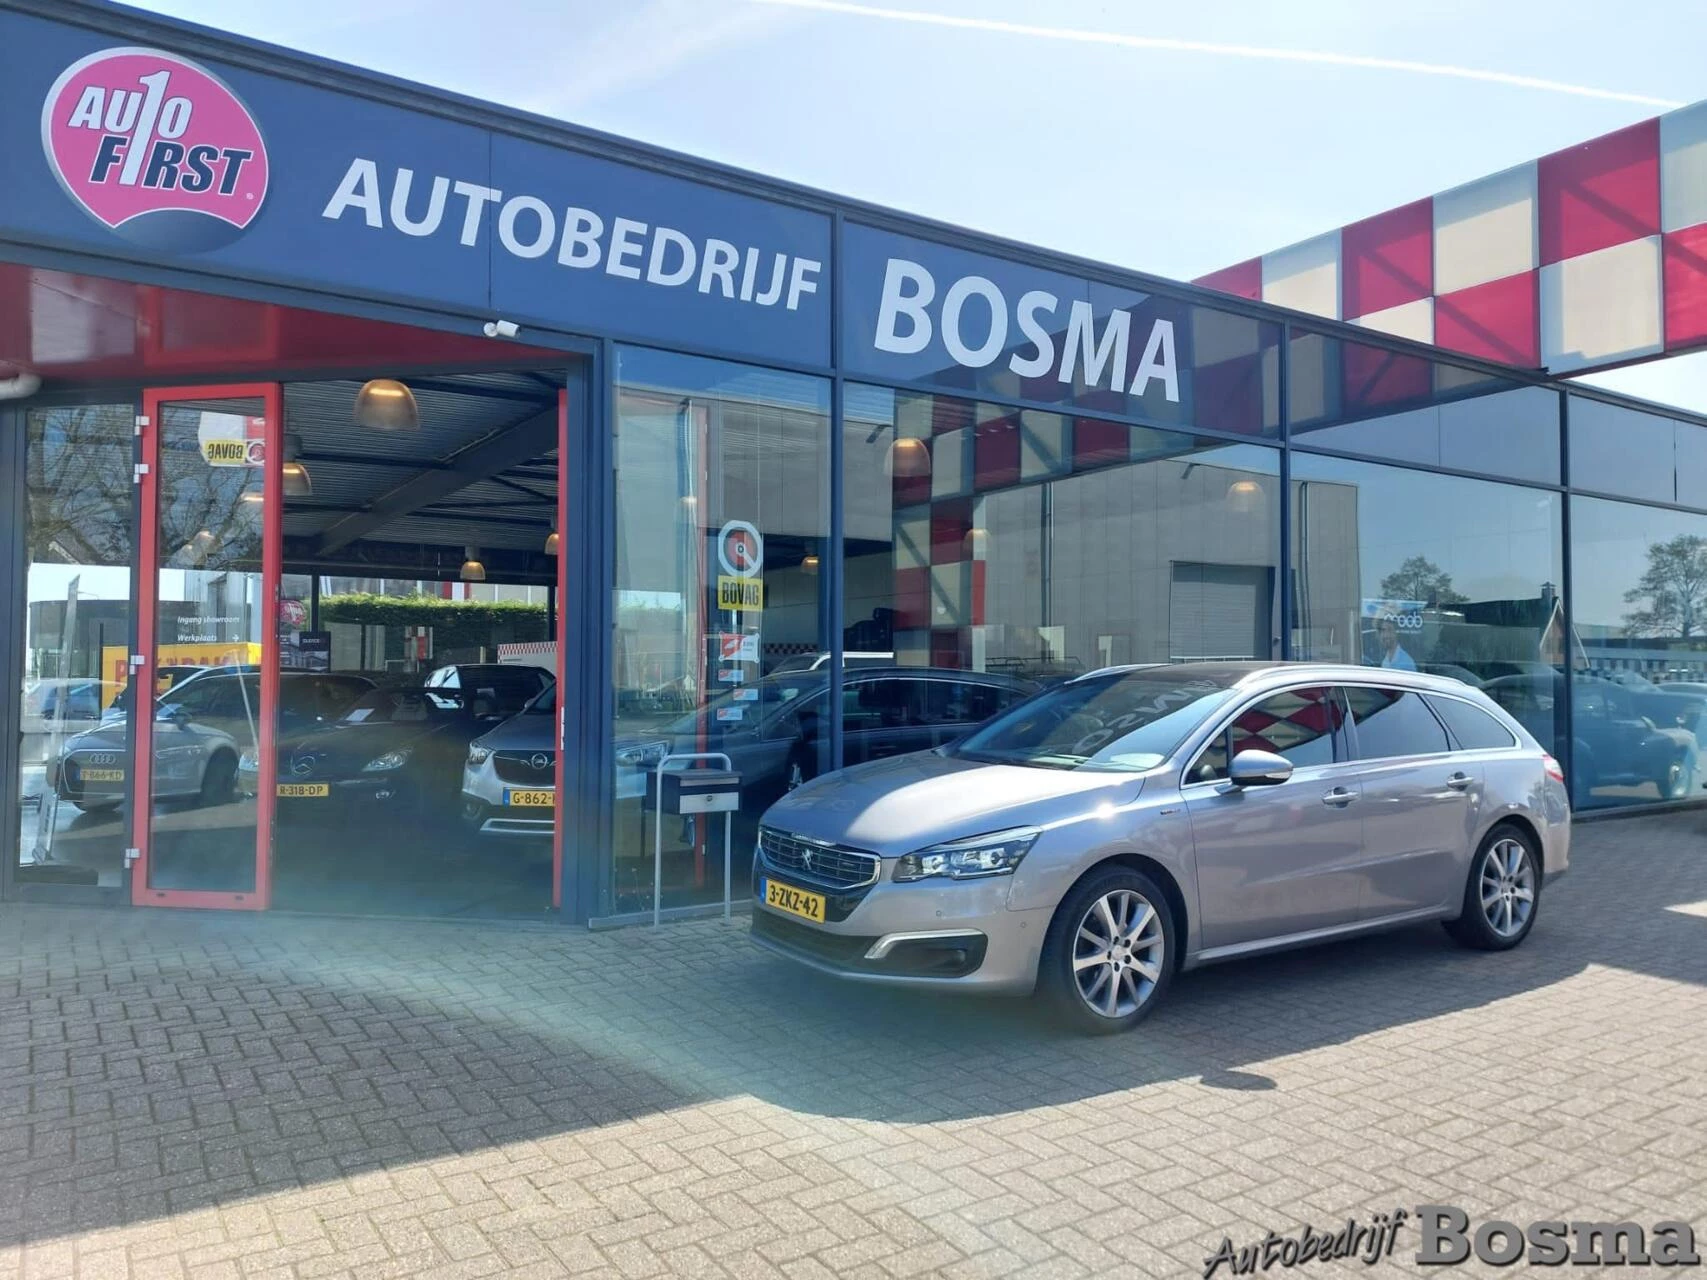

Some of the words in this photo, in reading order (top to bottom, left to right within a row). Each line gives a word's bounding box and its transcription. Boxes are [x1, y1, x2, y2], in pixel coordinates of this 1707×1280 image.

[322, 157, 821, 311] AUTOBEDRIJF
[874, 258, 1180, 403] BOSMA
[722, 581, 759, 607] BOVAG
[177, 616, 202, 625] Ingang
[177, 633, 217, 643] Werkplaats
[512, 792, 556, 805] G-862-
[768, 883, 819, 919] 3-ZKZ-42
